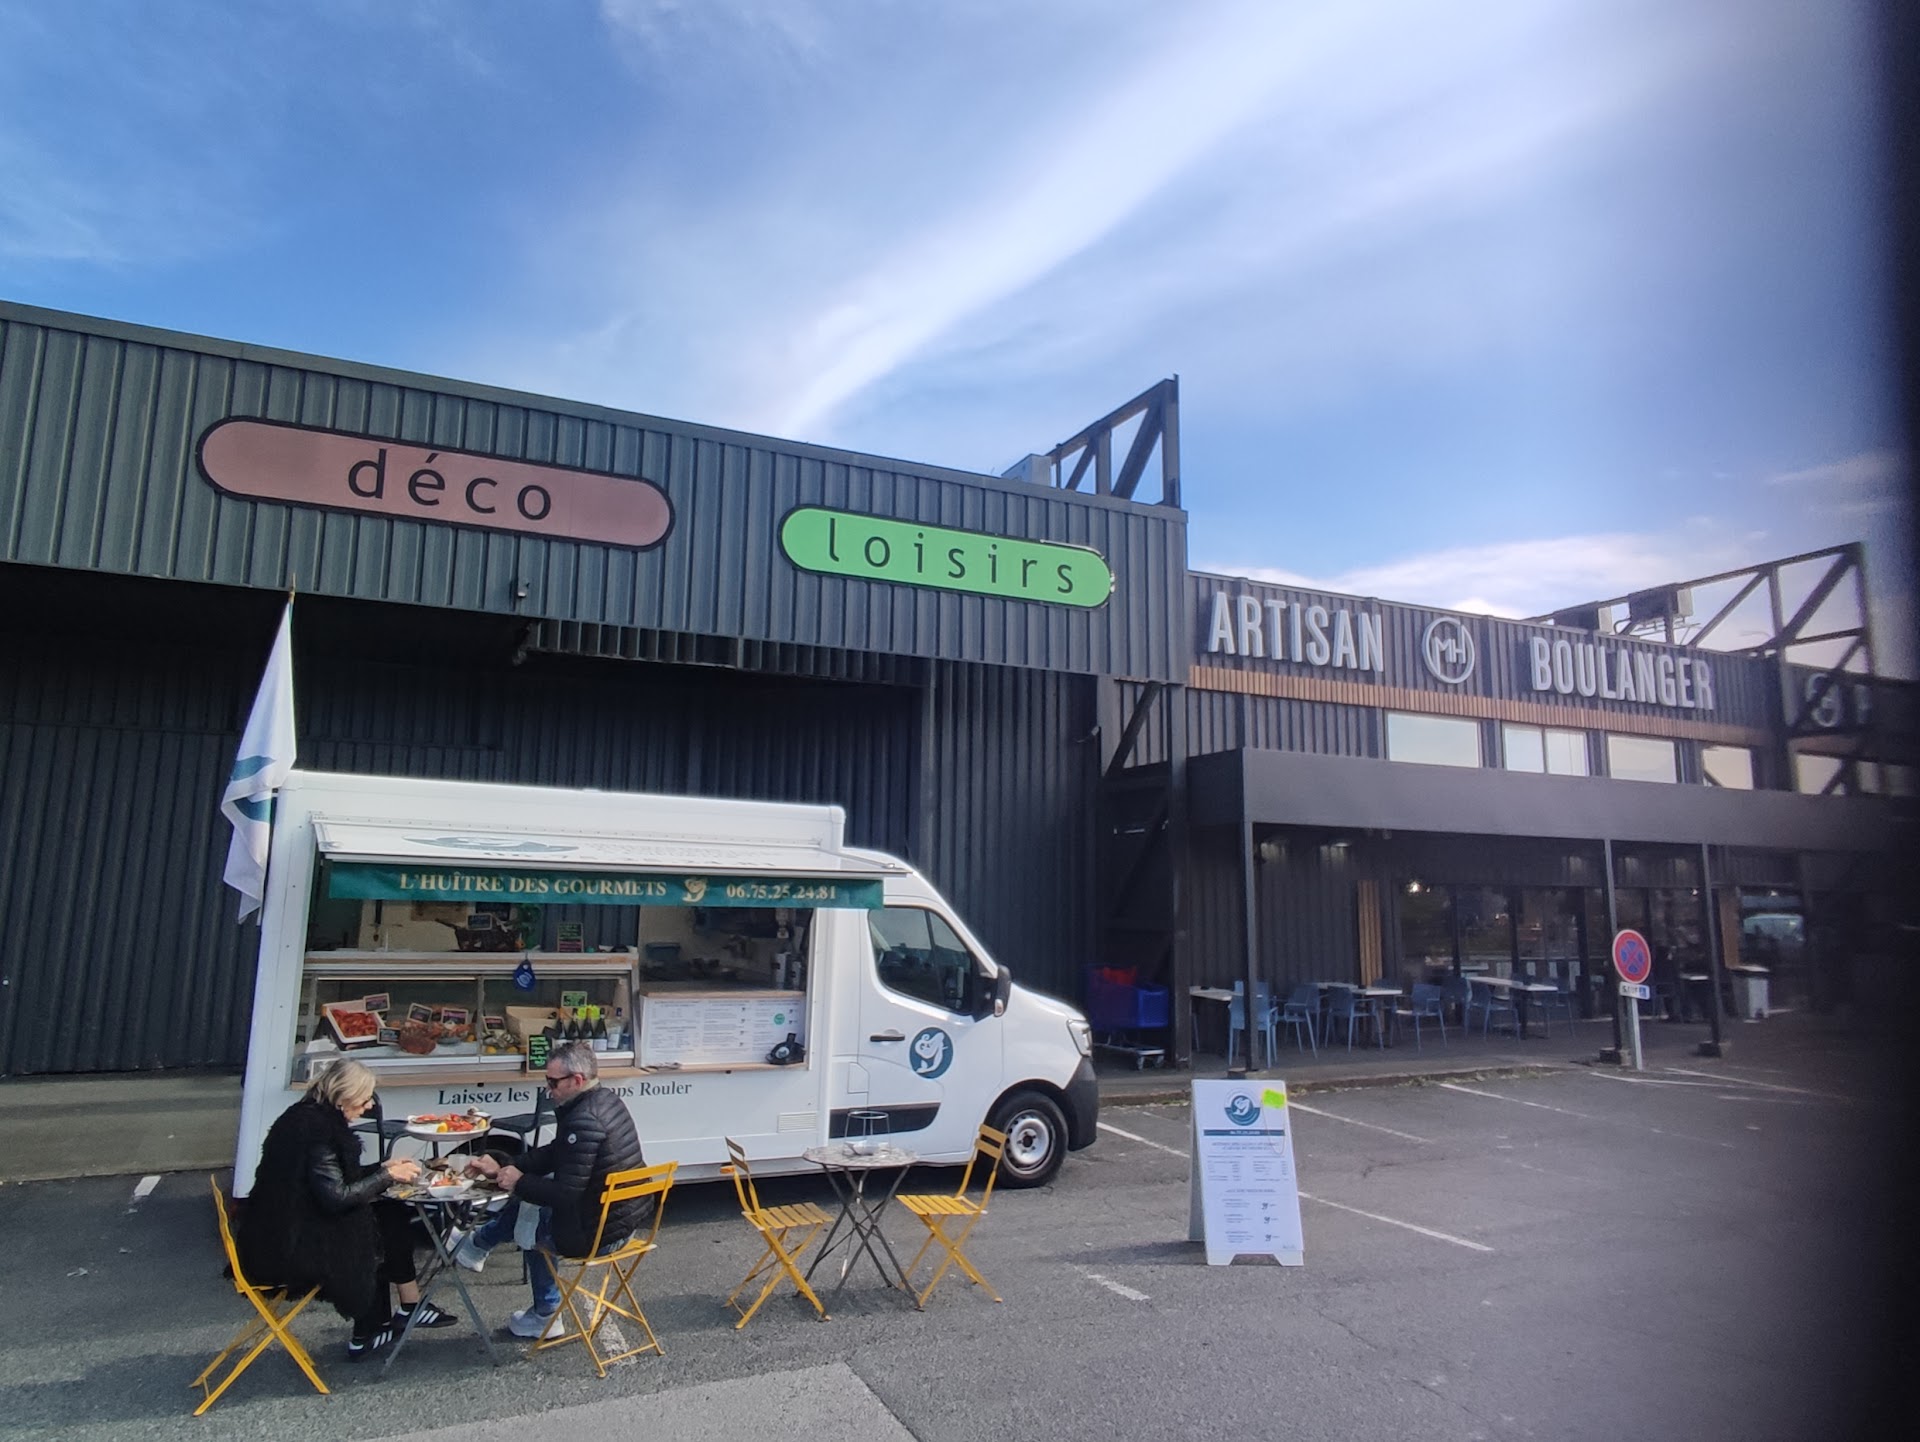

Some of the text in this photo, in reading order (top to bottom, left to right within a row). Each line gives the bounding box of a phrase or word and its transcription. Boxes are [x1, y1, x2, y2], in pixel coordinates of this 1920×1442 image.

[348, 448, 552, 521] déco
[828, 517, 1074, 595] loisirs
[1207, 591, 1384, 673] ARTISAN
[1529, 636, 1715, 711] BOULANGER
[401, 871, 837, 900] L'HUÎTRE DES GOURMETS 06.75.25.24.81
[438, 1087, 502, 1105] Laissez
[507, 1086, 531, 1103] les
[640, 1080, 692, 1097] Rouler
